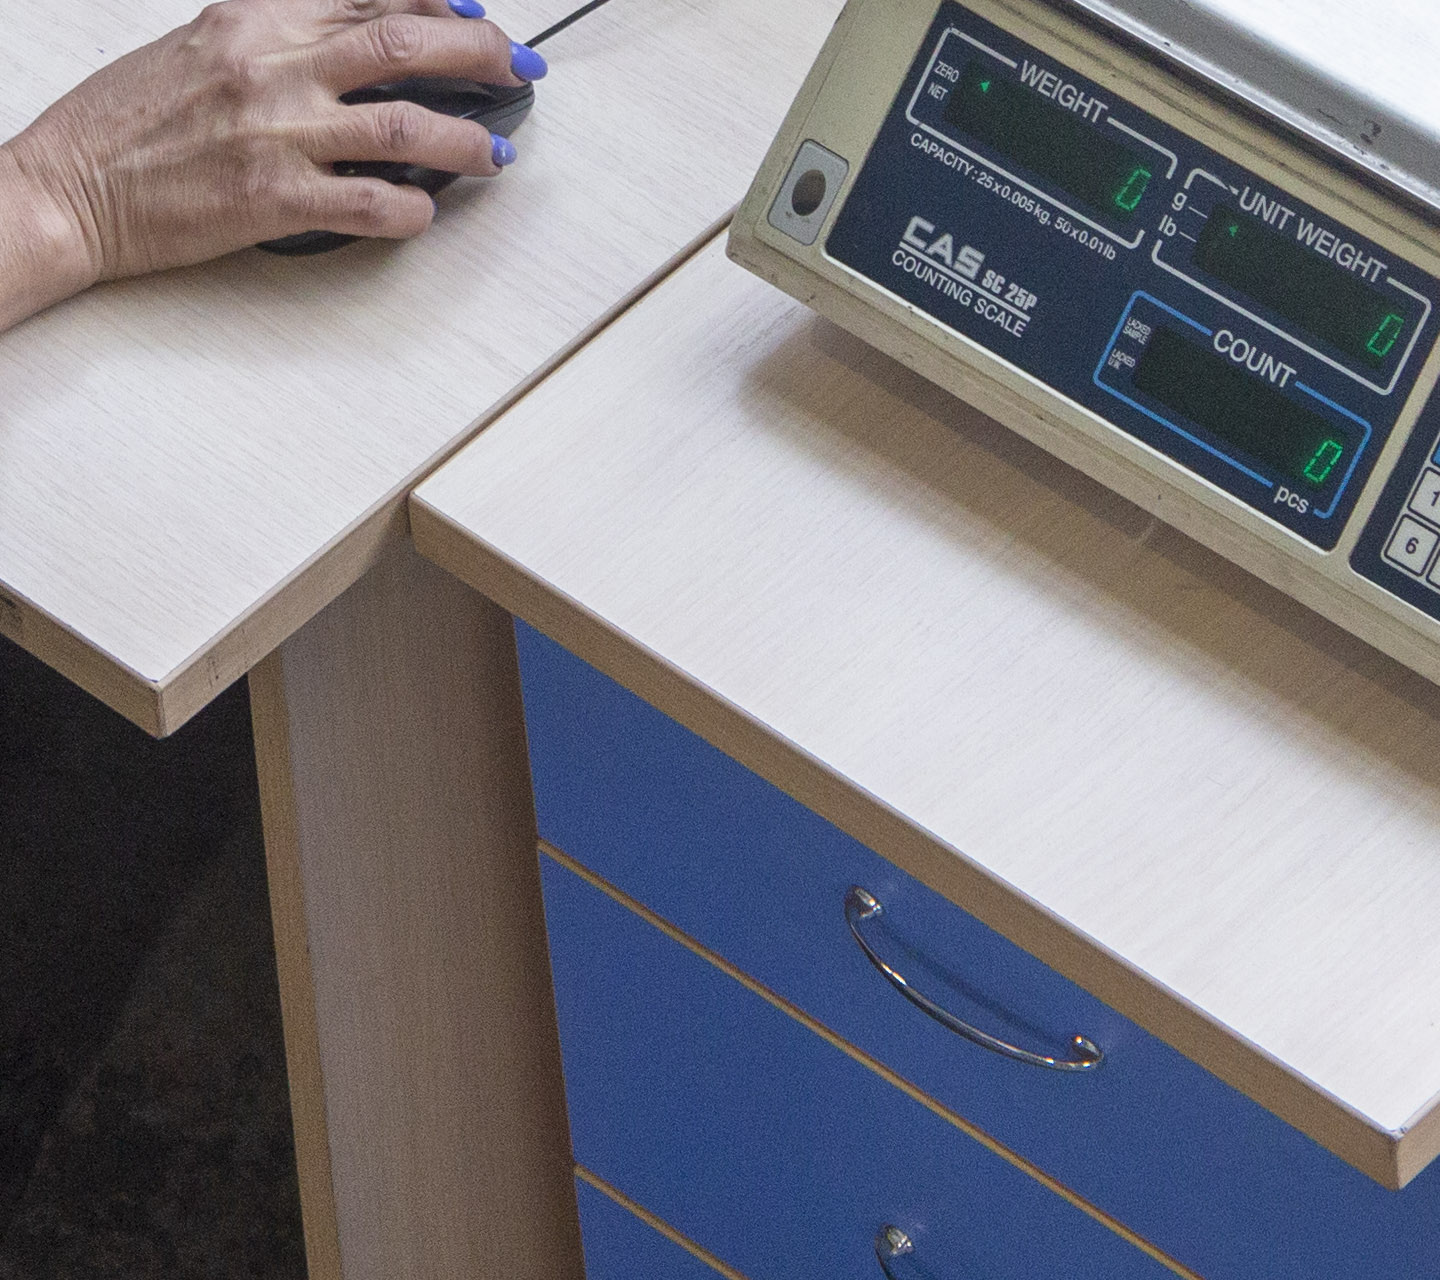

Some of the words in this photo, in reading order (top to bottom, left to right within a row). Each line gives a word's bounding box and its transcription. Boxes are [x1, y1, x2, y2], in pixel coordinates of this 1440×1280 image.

[936, 62, 958, 81] ZERO
[928, 84, 945, 100] NET
[1017, 62, 1106, 123] WEIGHT
[1115, 164, 1150, 212] 0
[1173, 192, 1186, 208] g
[1159, 217, 1177, 235] lb
[1239, 188, 1294, 231] UNIT
[1294, 220, 1385, 284] WEIGHT
[903, 215, 983, 278] CAS
[982, 270, 1004, 293] SC
[1005, 284, 1036, 311] 25P
[891, 250, 972, 306] COUNTING
[974, 297, 1025, 337] SCALE
[1128, 318, 1150, 335] LACKED
[1367, 310, 1402, 357] 0
[1113, 350, 1134, 367] LACKED
[1212, 328, 1295, 390] COUNT
[1304, 436, 1341, 485] 0
[1275, 484, 1309, 516] pcs
[1429, 490, 1439, 505] 1
[1404, 537, 1418, 554] 6
